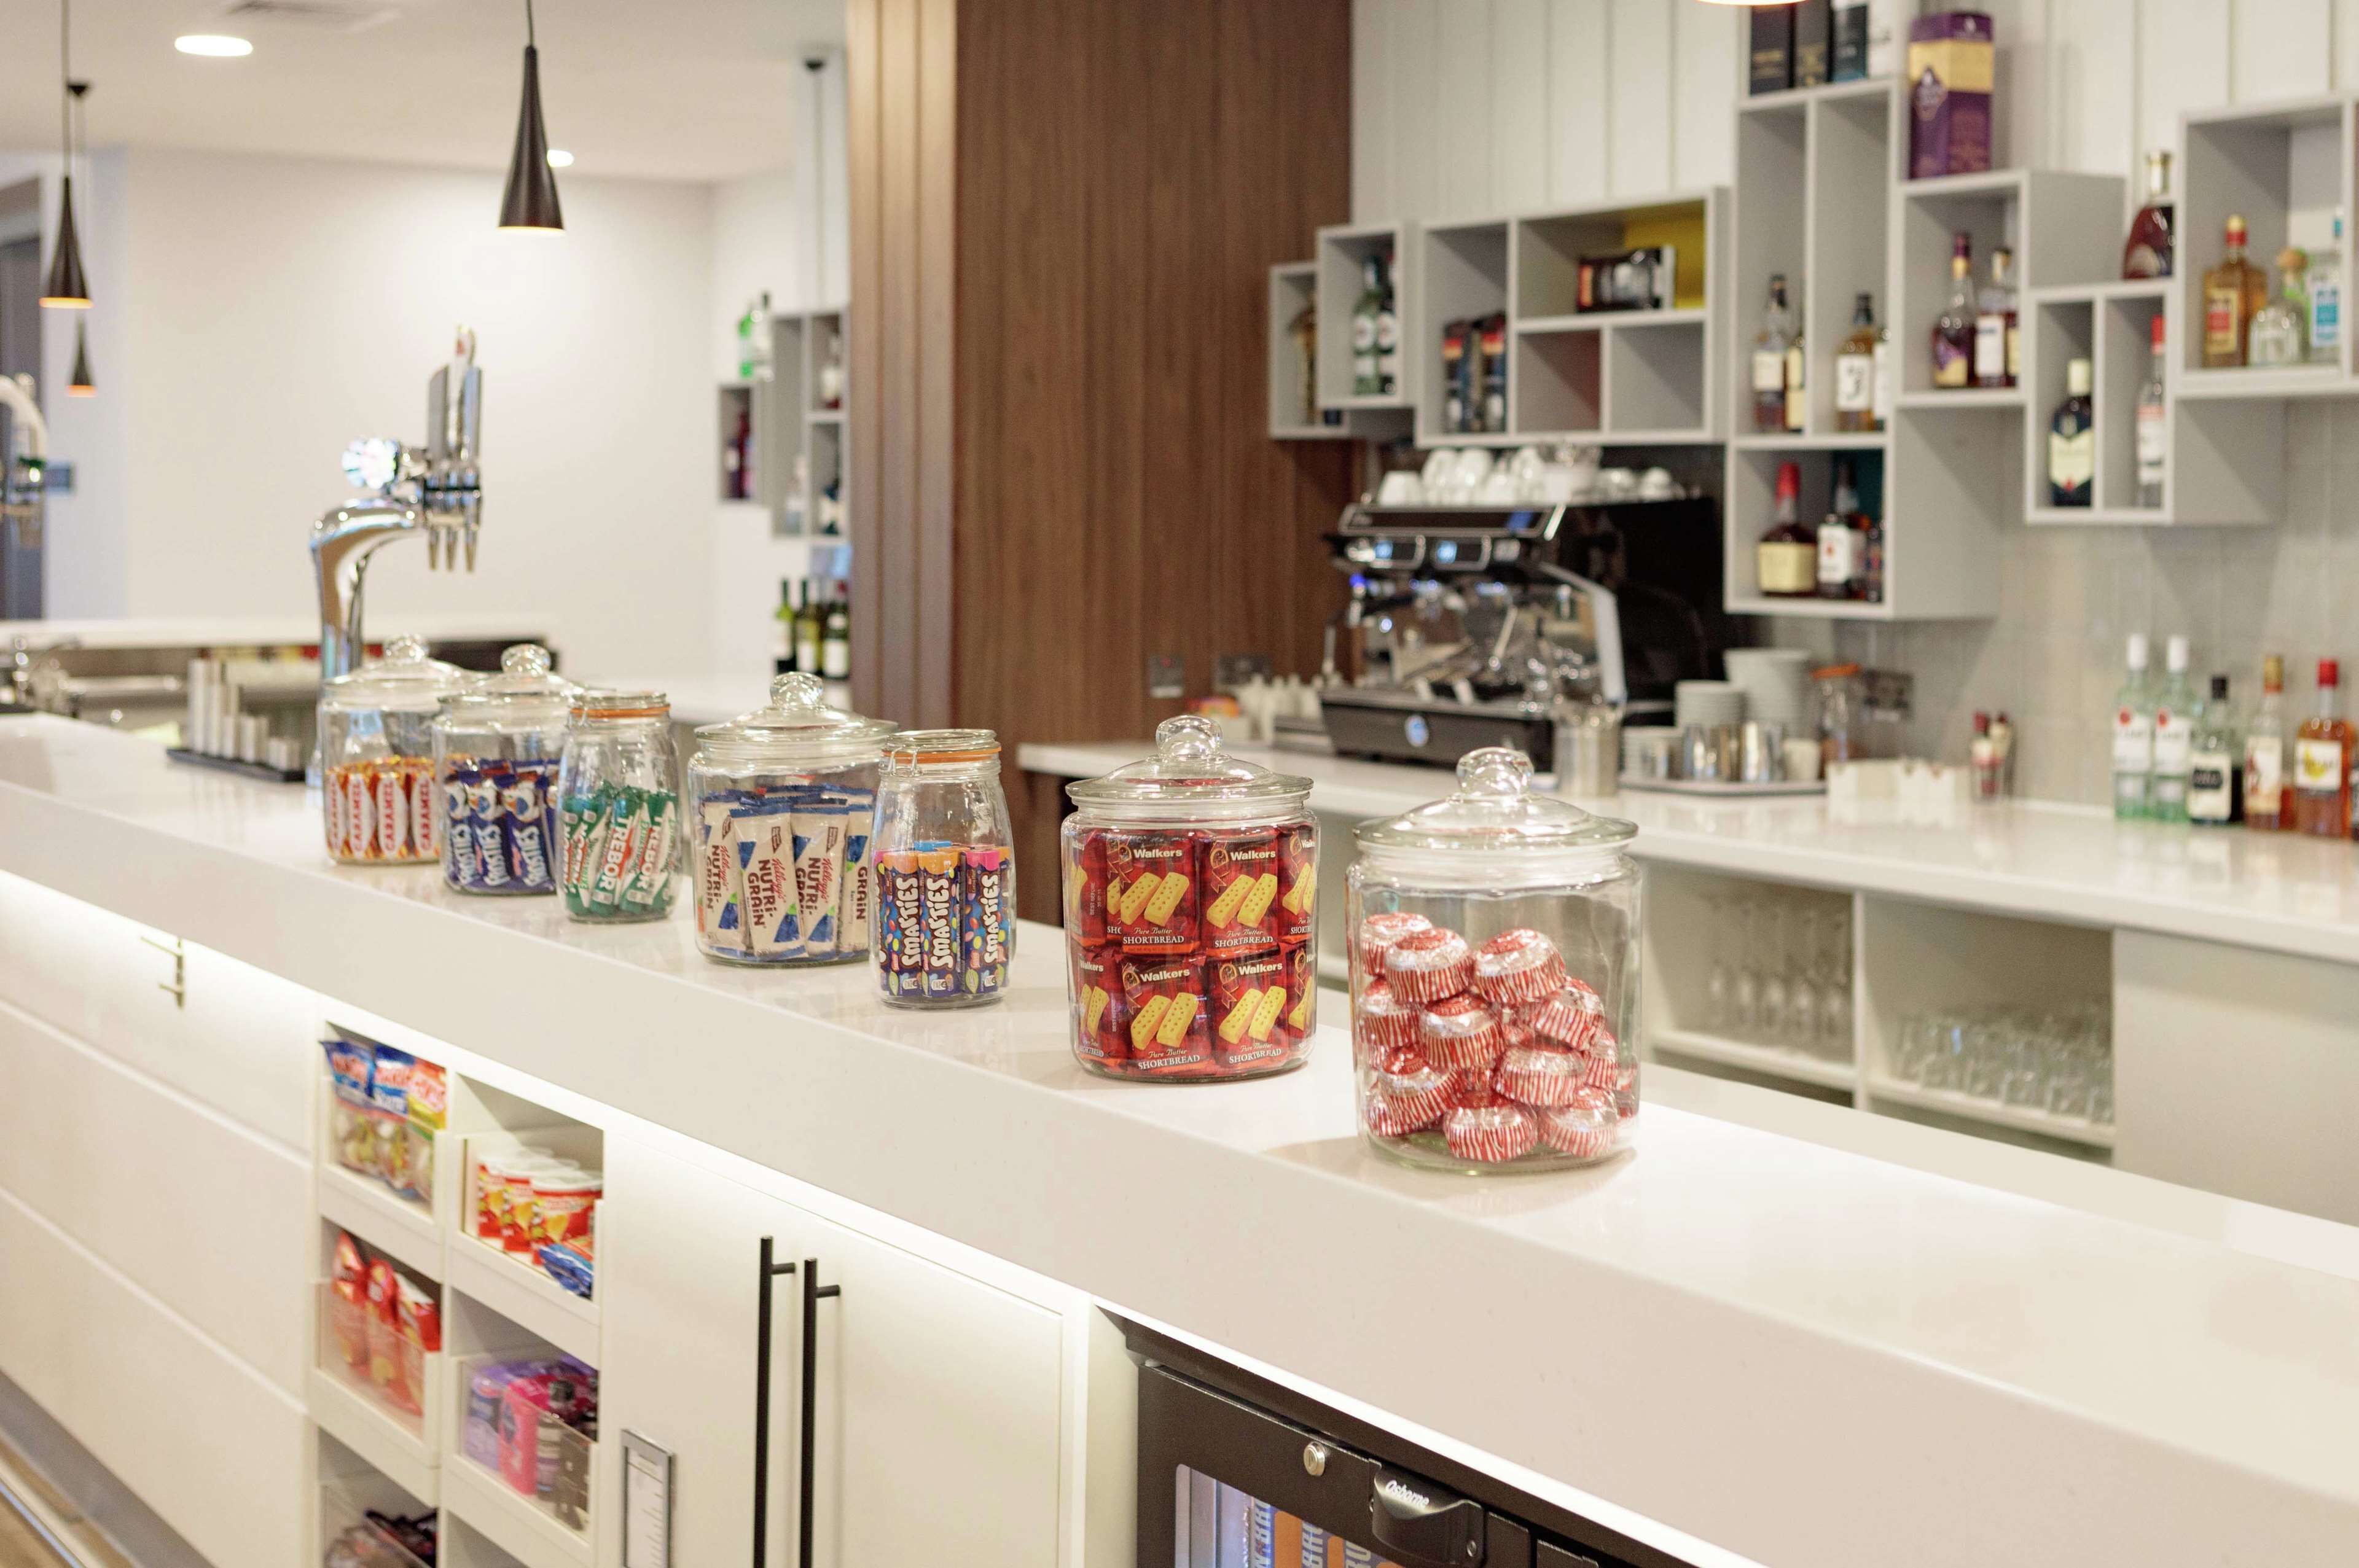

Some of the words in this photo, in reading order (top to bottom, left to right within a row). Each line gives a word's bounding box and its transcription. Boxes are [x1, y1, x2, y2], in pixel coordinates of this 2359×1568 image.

[353, 778, 364, 851] CARAMEL
[383, 779, 396, 852] CARAMEL
[419, 778, 432, 851] CARAMEL
[598, 815, 633, 891] TREBOR
[1133, 849, 1183, 859] Walkers
[1230, 850, 1276, 860] Walkers
[772, 858, 787, 899] Kellogg's
[818, 859, 832, 900] Kellogg's
[1123, 935, 1184, 944] SHORTBREAD
[1215, 936, 1273, 948] SHORTBREAD
[1080, 960, 1104, 972] Walkers
[1238, 963, 1283, 975] Walkers
[1140, 969, 1190, 982] Walkers
[1138, 1055, 1200, 1069] SHORTBREAD
[1229, 1048, 1281, 1064] SHORTBREAD
[1386, 1480, 1430, 1510] Osborne
